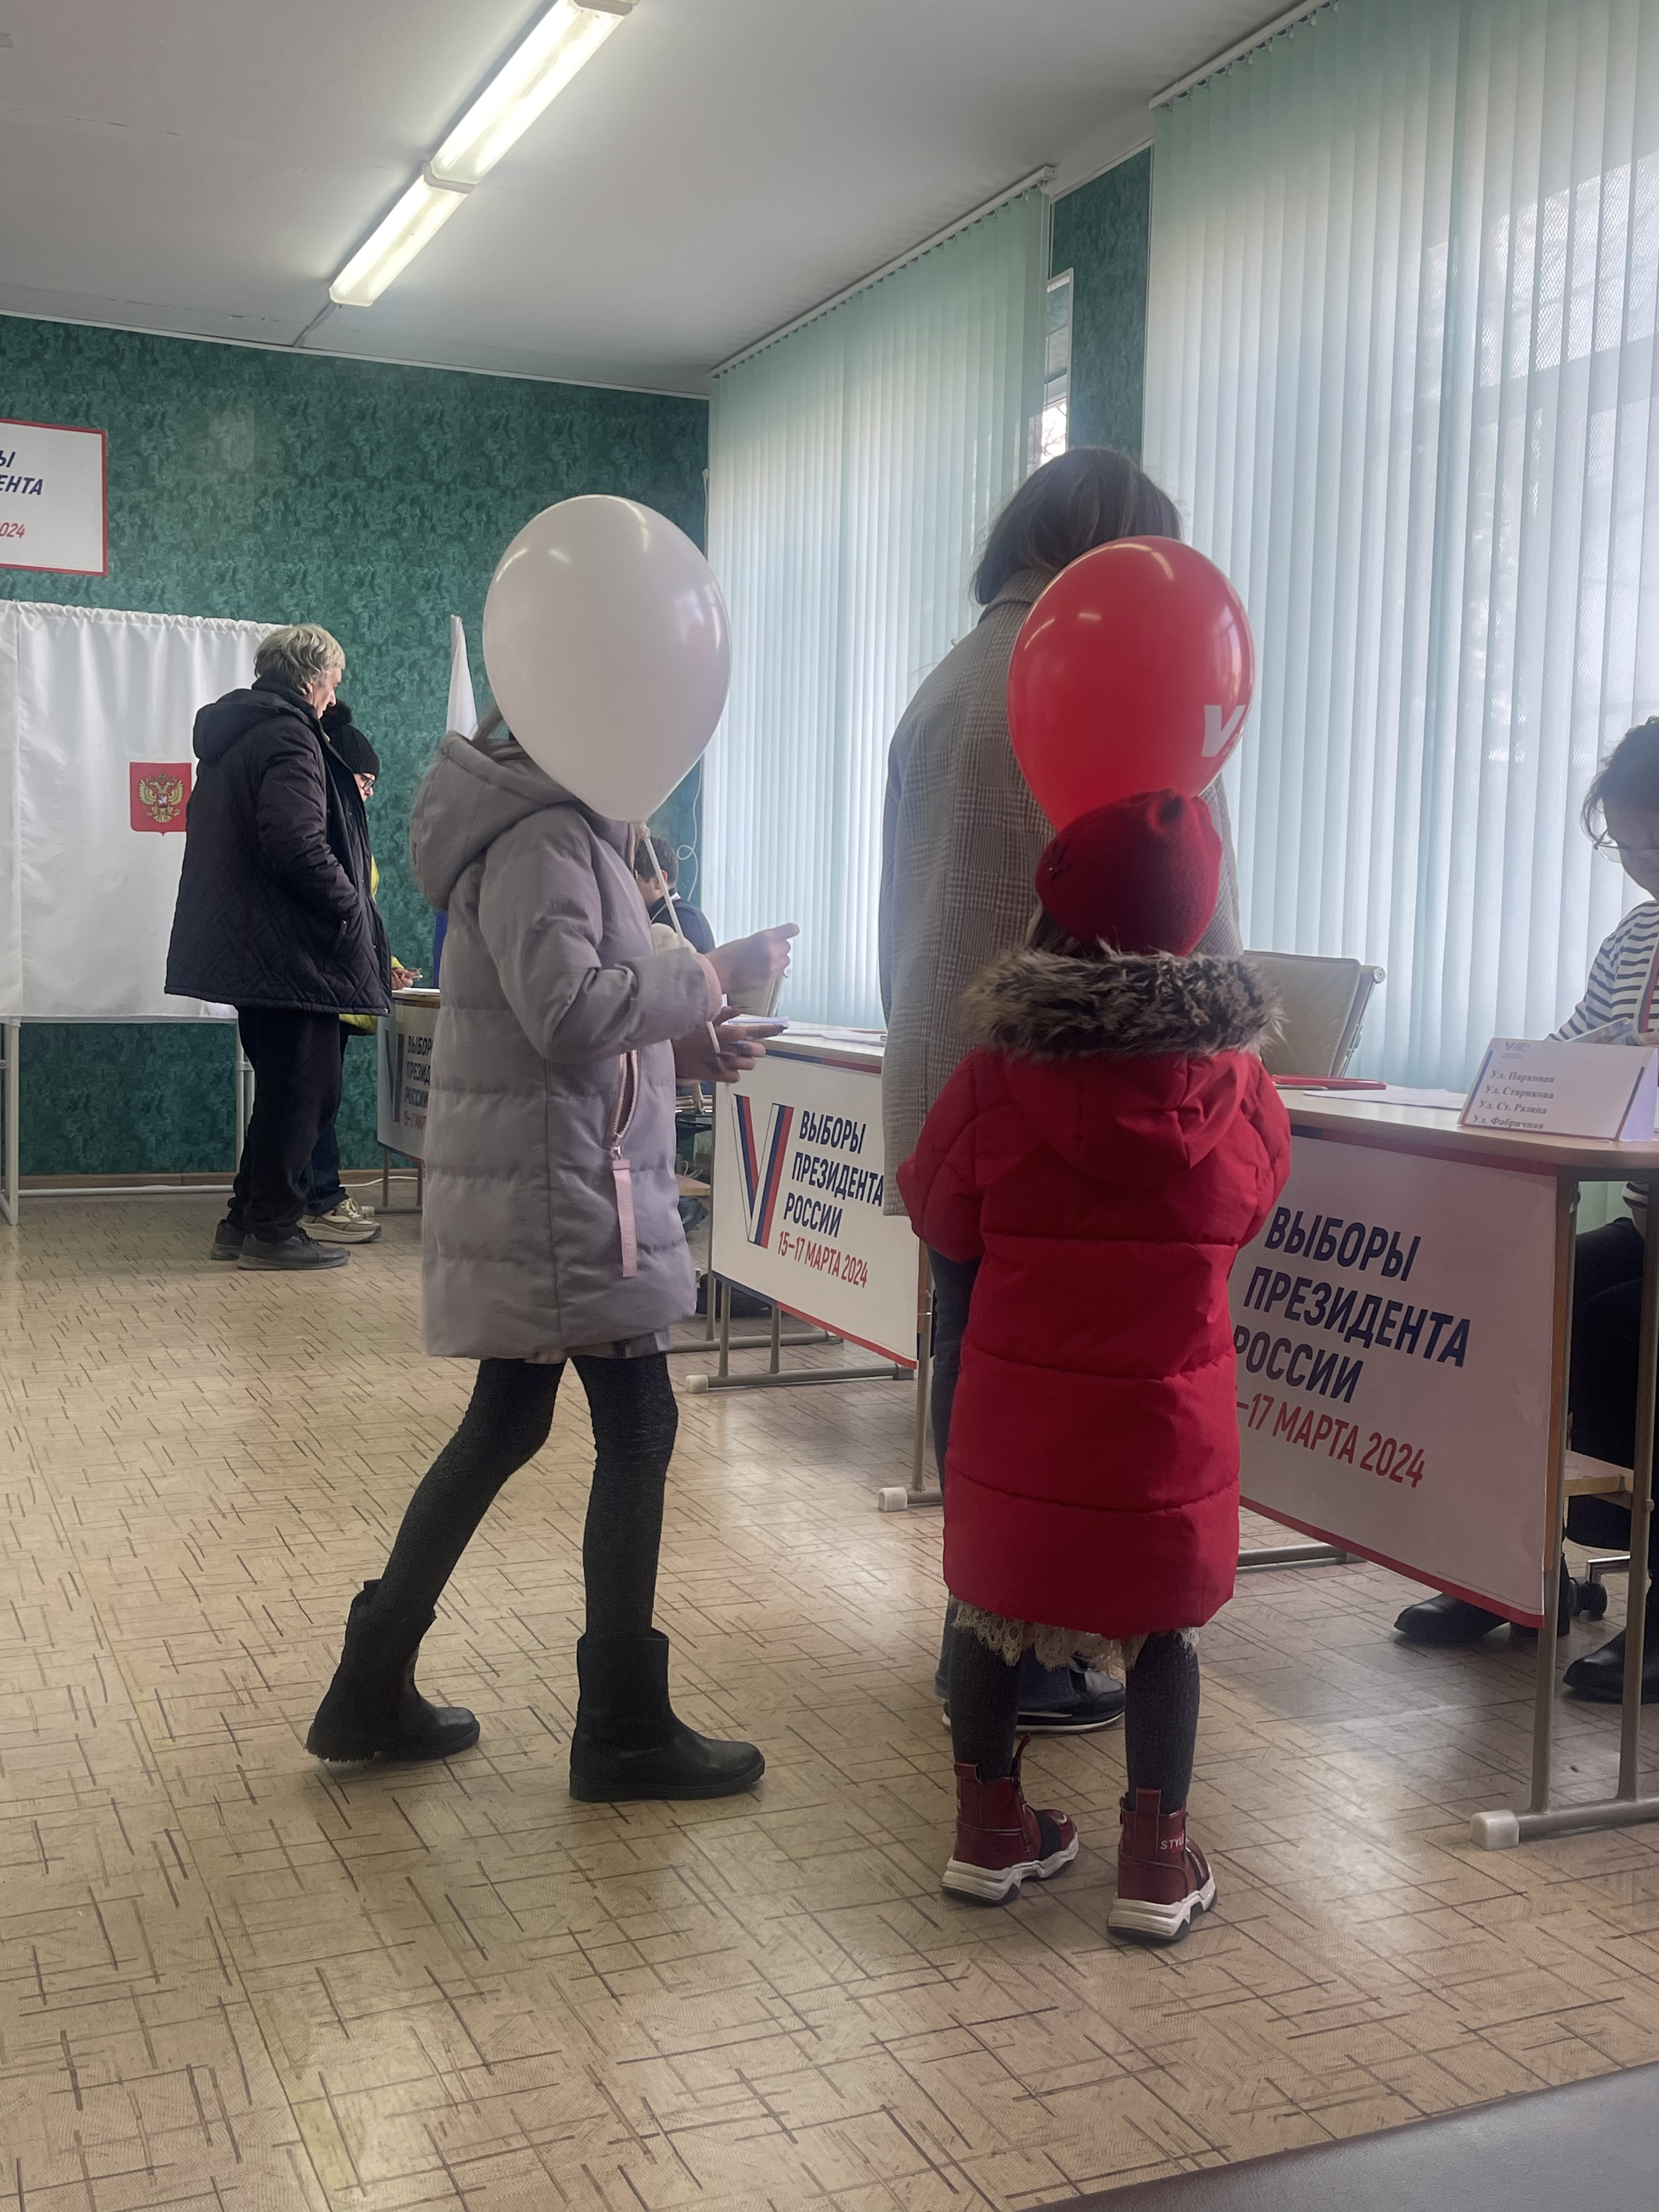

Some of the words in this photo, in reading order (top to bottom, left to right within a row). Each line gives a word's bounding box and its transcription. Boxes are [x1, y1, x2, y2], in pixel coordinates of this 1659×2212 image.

[0, 522, 25, 538] 024
[1485, 1085, 1499, 1094] Ул.
[1503, 1087, 1554, 1099] Старикова
[1491, 1070, 1505, 1080] Ул.
[1508, 1071, 1555, 1083] Парковая
[1472, 1115, 1487, 1124] Ул.
[1490, 1117, 1544, 1130] Фабричная
[1479, 1100, 1494, 1109] Ул.
[1497, 1102, 1511, 1111] Ст.
[1514, 1103, 1547, 1114] Разина
[799, 1110, 866, 1154] ВЫБОРЫ
[791, 1152, 884, 1207] ПРЕЗИДЕНТА
[783, 1192, 843, 1238] РОССИИ
[804, 1242, 840, 1277] МАРТА
[841, 1255, 868, 1288] 2024
[1264, 1206, 1421, 1282] ВЫБОРЫ
[1243, 1266, 1471, 1368] ПРЕЗИДЕНТА
[1233, 1325, 1364, 1404] РОССИИ
[1235, 1385, 1274, 1431] –17
[1272, 1401, 1359, 1464] МАРТА
[1359, 1432, 1426, 1488] 2024
